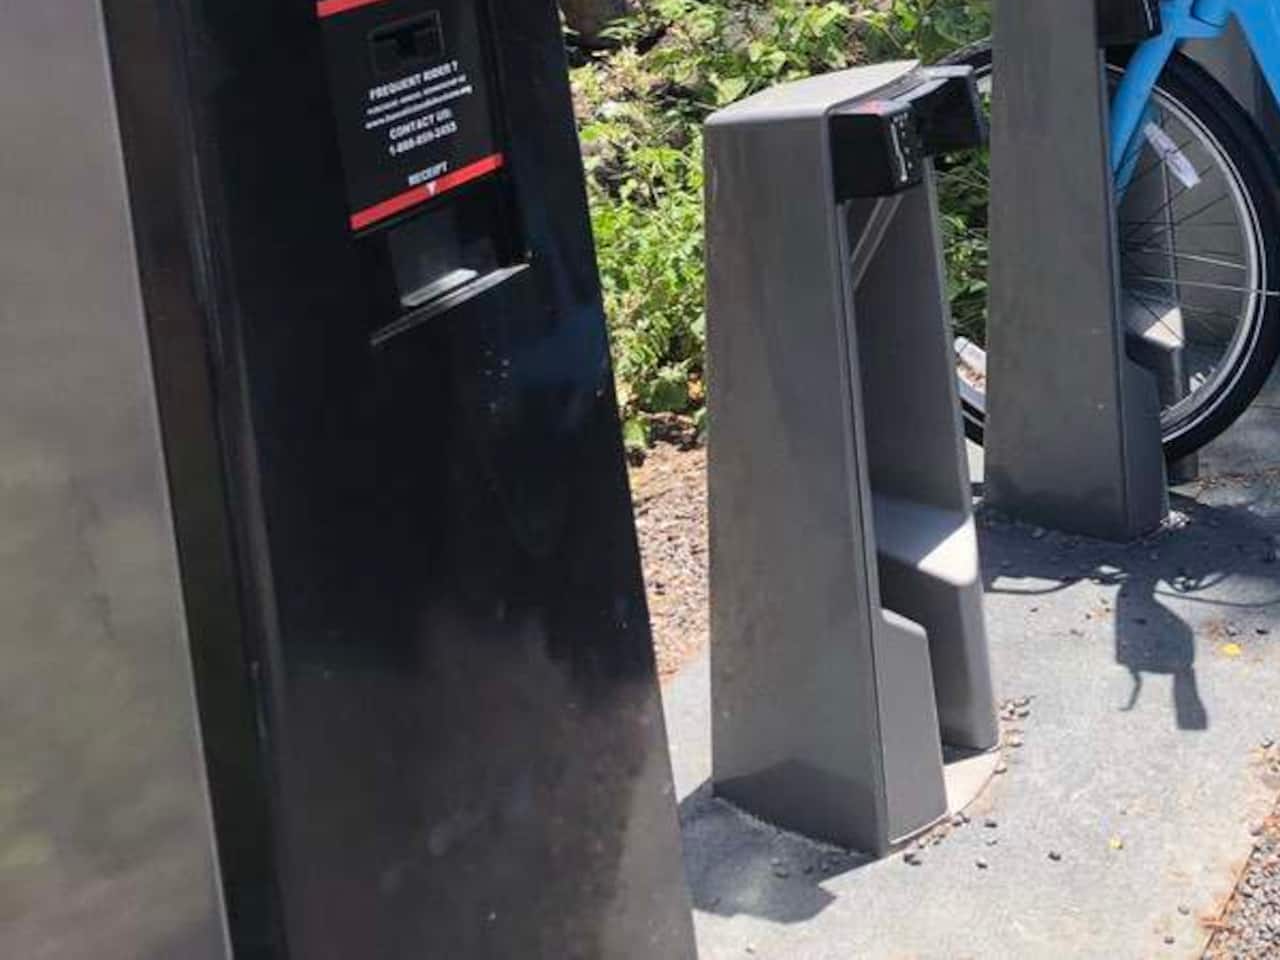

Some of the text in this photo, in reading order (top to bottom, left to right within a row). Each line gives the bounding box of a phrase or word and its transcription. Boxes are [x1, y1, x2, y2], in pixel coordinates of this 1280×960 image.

[369, 73, 421, 100] FREQUENT
[423, 63, 452, 82] RIDER
[388, 114, 435, 140] CONTACT
[408, 160, 448, 186] RECEIPT
